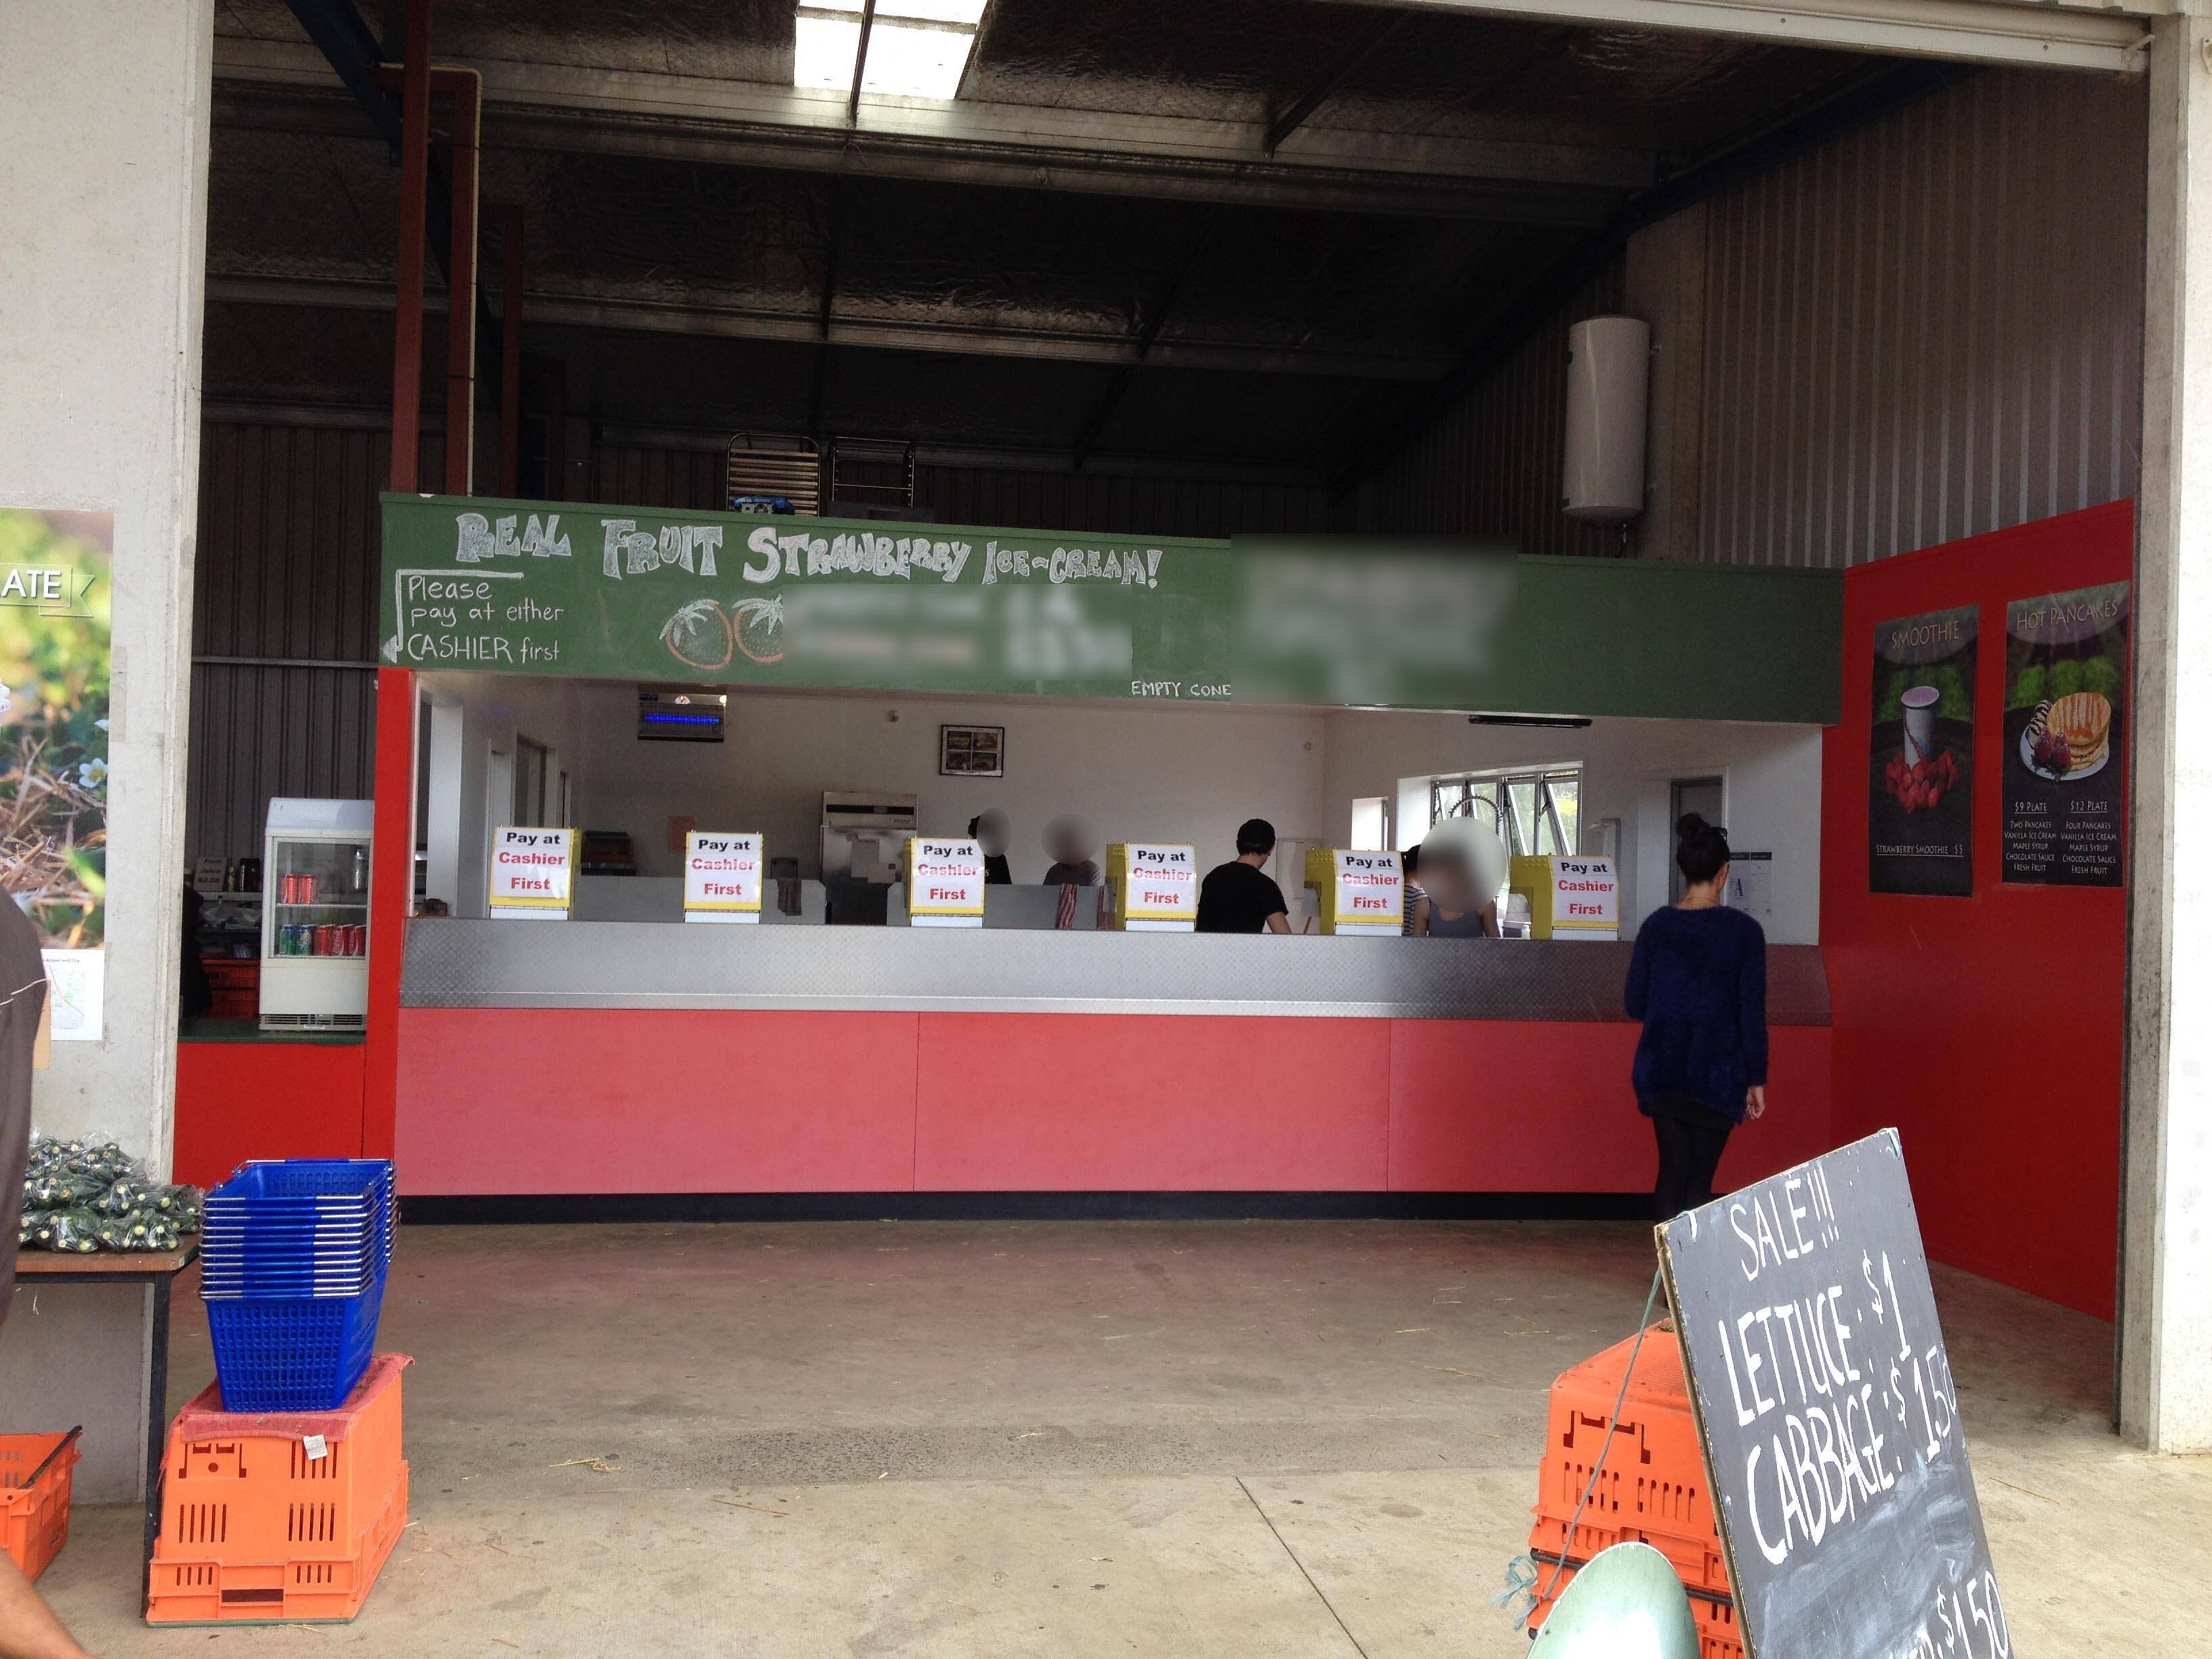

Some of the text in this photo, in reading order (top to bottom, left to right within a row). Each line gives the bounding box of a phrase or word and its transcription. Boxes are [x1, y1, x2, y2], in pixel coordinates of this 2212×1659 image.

[456, 513, 571, 562] REAL
[601, 519, 722, 579] FRUIT
[743, 527, 972, 583] STRAWBERRY
[408, 575, 493, 600] Please
[411, 598, 564, 627] pay at either
[2016, 600, 2118, 632] HOT PANCAKES
[1891, 619, 1959, 649] SMOOTHIE
[408, 634, 559, 663] CASHIER first
[1131, 680, 1231, 697] EMPTY CONE
[2015, 801, 2047, 812] $9 PLATE
[2070, 800, 2108, 811] $12 PLATE
[2024, 821, 2051, 829] PANCAKES
[2066, 821, 2111, 830] FOUR PANCAKES
[506, 832, 560, 846] Pay at
[2038, 832, 2056, 840] CREAM
[2096, 833, 2117, 841] CREAM
[699, 840, 750, 852] Pay at
[924, 845, 973, 857] Pay at
[1876, 844, 1914, 853] STRAWBERRY
[1915, 844, 1948, 855] SMOOTHIE
[2069, 844, 2108, 852] MAPLE SYRUP
[499, 852, 565, 865] Cashier
[1137, 850, 1186, 863] Pay at
[2005, 853, 2055, 861] CHOCOLATE SAUCE
[2062, 855, 2116, 863] CHOCOLATE SAUCE
[692, 859, 755, 870] Cashier
[1346, 857, 1393, 869] Pay at
[1561, 862, 1607, 874] Pay at
[2013, 863, 2047, 872] FRESH FRUIT
[918, 863, 979, 876] Cashier
[1133, 867, 1192, 880] Cashier
[2071, 865, 2108, 874] FRESH FRUIT
[511, 878, 550, 890] First
[1343, 874, 1399, 885] Cashier
[704, 884, 742, 895] First
[1558, 880, 1614, 892] Cashier
[930, 888, 966, 900] First
[1144, 892, 1179, 904] First
[1353, 897, 1388, 908] First
[1570, 903, 1603, 915] First
